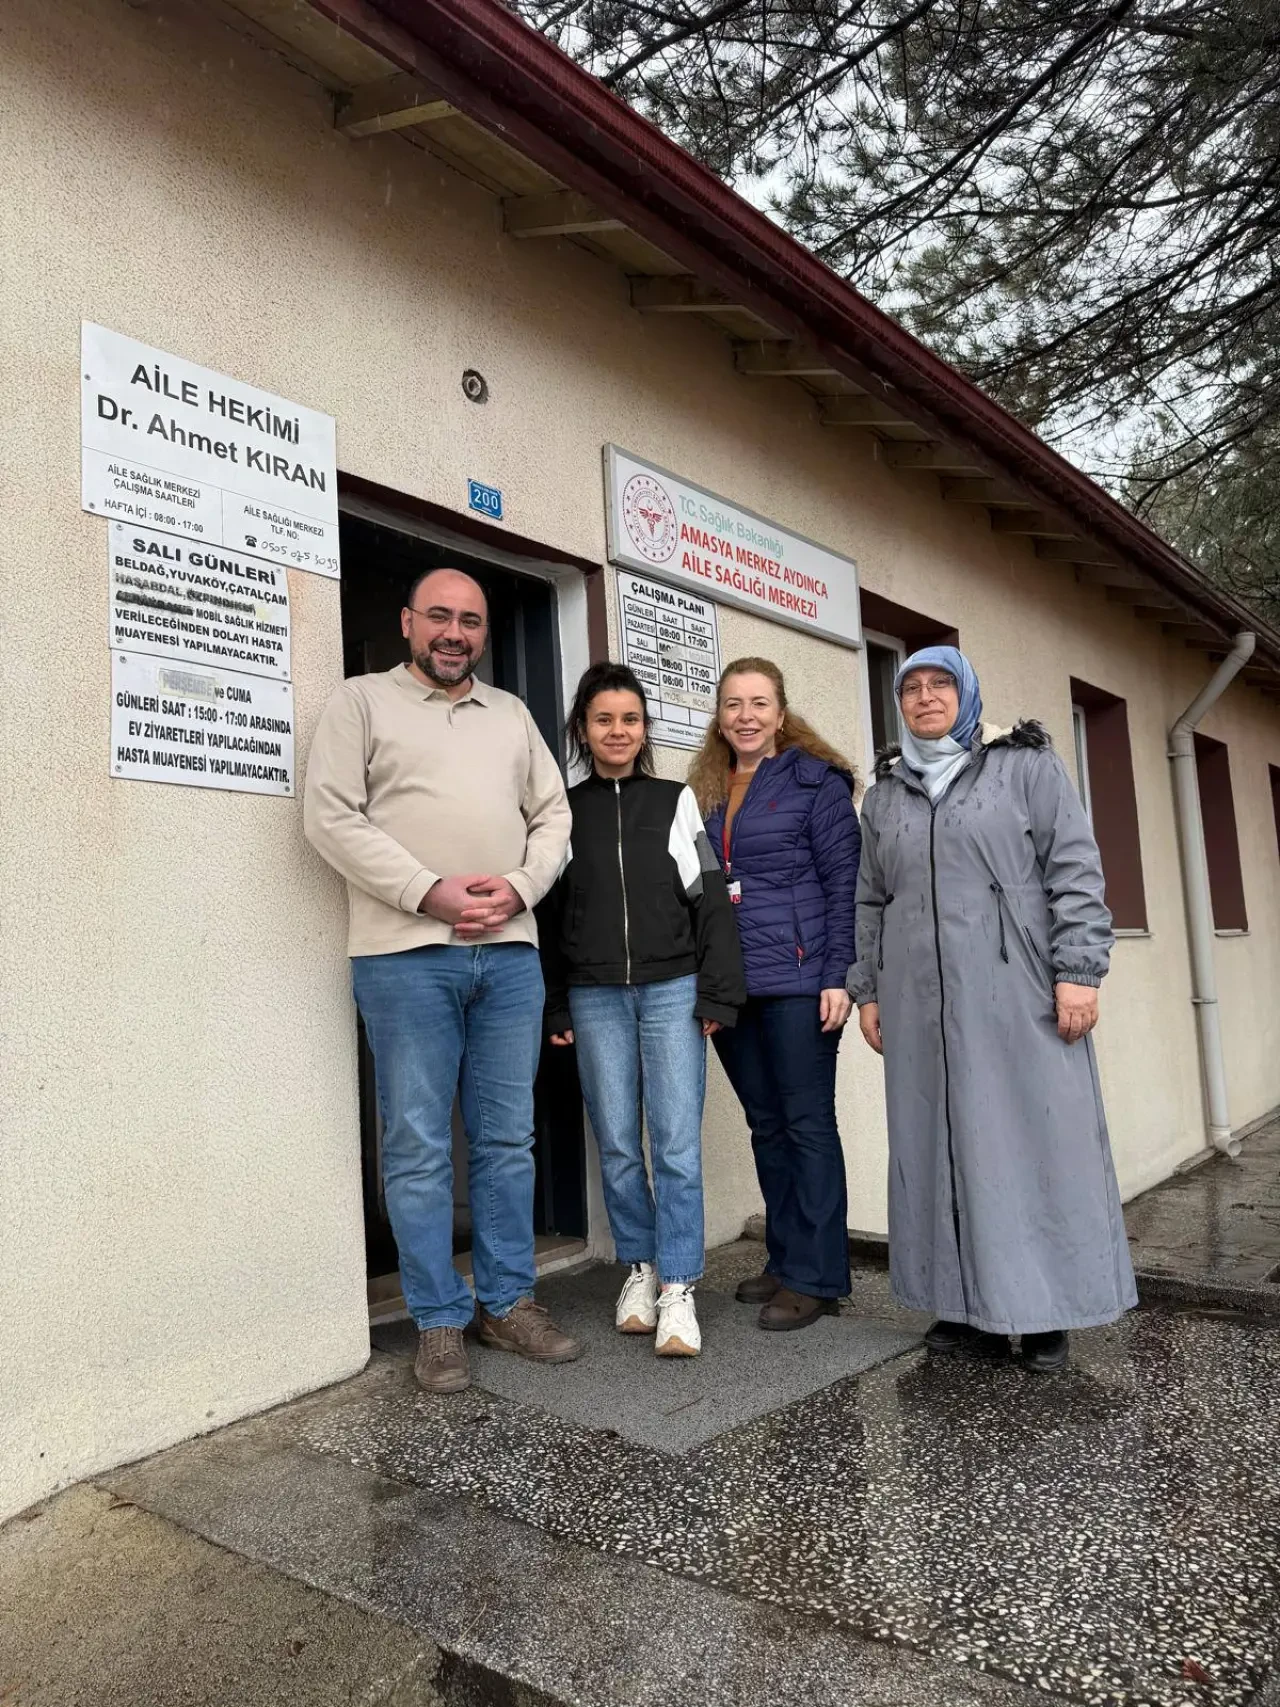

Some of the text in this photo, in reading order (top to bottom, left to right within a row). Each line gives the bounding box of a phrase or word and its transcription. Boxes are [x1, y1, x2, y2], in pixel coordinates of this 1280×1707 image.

[130, 364, 300, 445] AİLE HEKİMİ
[97, 394, 326, 492] Dr. Ahmet KIRAN
[107, 463, 201, 499] AİLE SAĞLIK MERKEZİ
[113, 478, 195, 508] ÇALIŞMA SAATLERİ
[104, 498, 134, 515] HAFTA
[135, 504, 147, 519] İÇİ
[154, 512, 176, 526] 08:00
[183, 520, 204, 533] 17:00
[474, 488, 499, 510] 200
[244, 504, 324, 537] AİLE SAĞLIĞI MERKEZİ
[678, 494, 698, 519] T.C.
[700, 504, 735, 533] Sağlık
[736, 522, 784, 558] Bakanlığı
[132, 538, 276, 586] SALI GÜNLERİ
[680, 523, 829, 600] AMASYA MERKEZ AYDINCA
[631, 582, 705, 616] ÇALIŞMA PLANI
[682, 550, 818, 620] AİLE SAĞLIĞI MERKEZİ
[115, 608, 284, 652] VERİLECEĞİNDEN DOLAYI HASTA
[196, 607, 288, 638] MOBİL SAĞLIK HİZMETİ
[627, 603, 706, 635] GÜNLER SAAT SAAT
[627, 618, 656, 634] PAZARTESİ
[660, 626, 681, 640] 08:00
[688, 635, 708, 648] 17:00
[115, 625, 279, 667] MUAYENESİ YAPILMAYACAKTIR.
[636, 637, 648, 648] SALI
[629, 651, 710, 679] ÇARŞAMBA 08:00 17:00
[214, 686, 225, 699] ve
[226, 686, 252, 704] CUMA
[662, 674, 684, 688] 08:00
[690, 681, 711, 694] 17:00
[116, 690, 159, 714] GÜNLERİ
[161, 699, 186, 718] SAAT
[193, 705, 218, 722] 15:00
[224, 711, 248, 727] 17:00
[249, 715, 292, 735] ARASINDA
[128, 720, 282, 757] EV ZİYARETLERİ YAPILACAĞINDAN
[117, 746, 290, 783] HASTA MUAYENESİ YAPILMAYACAKTIR.
